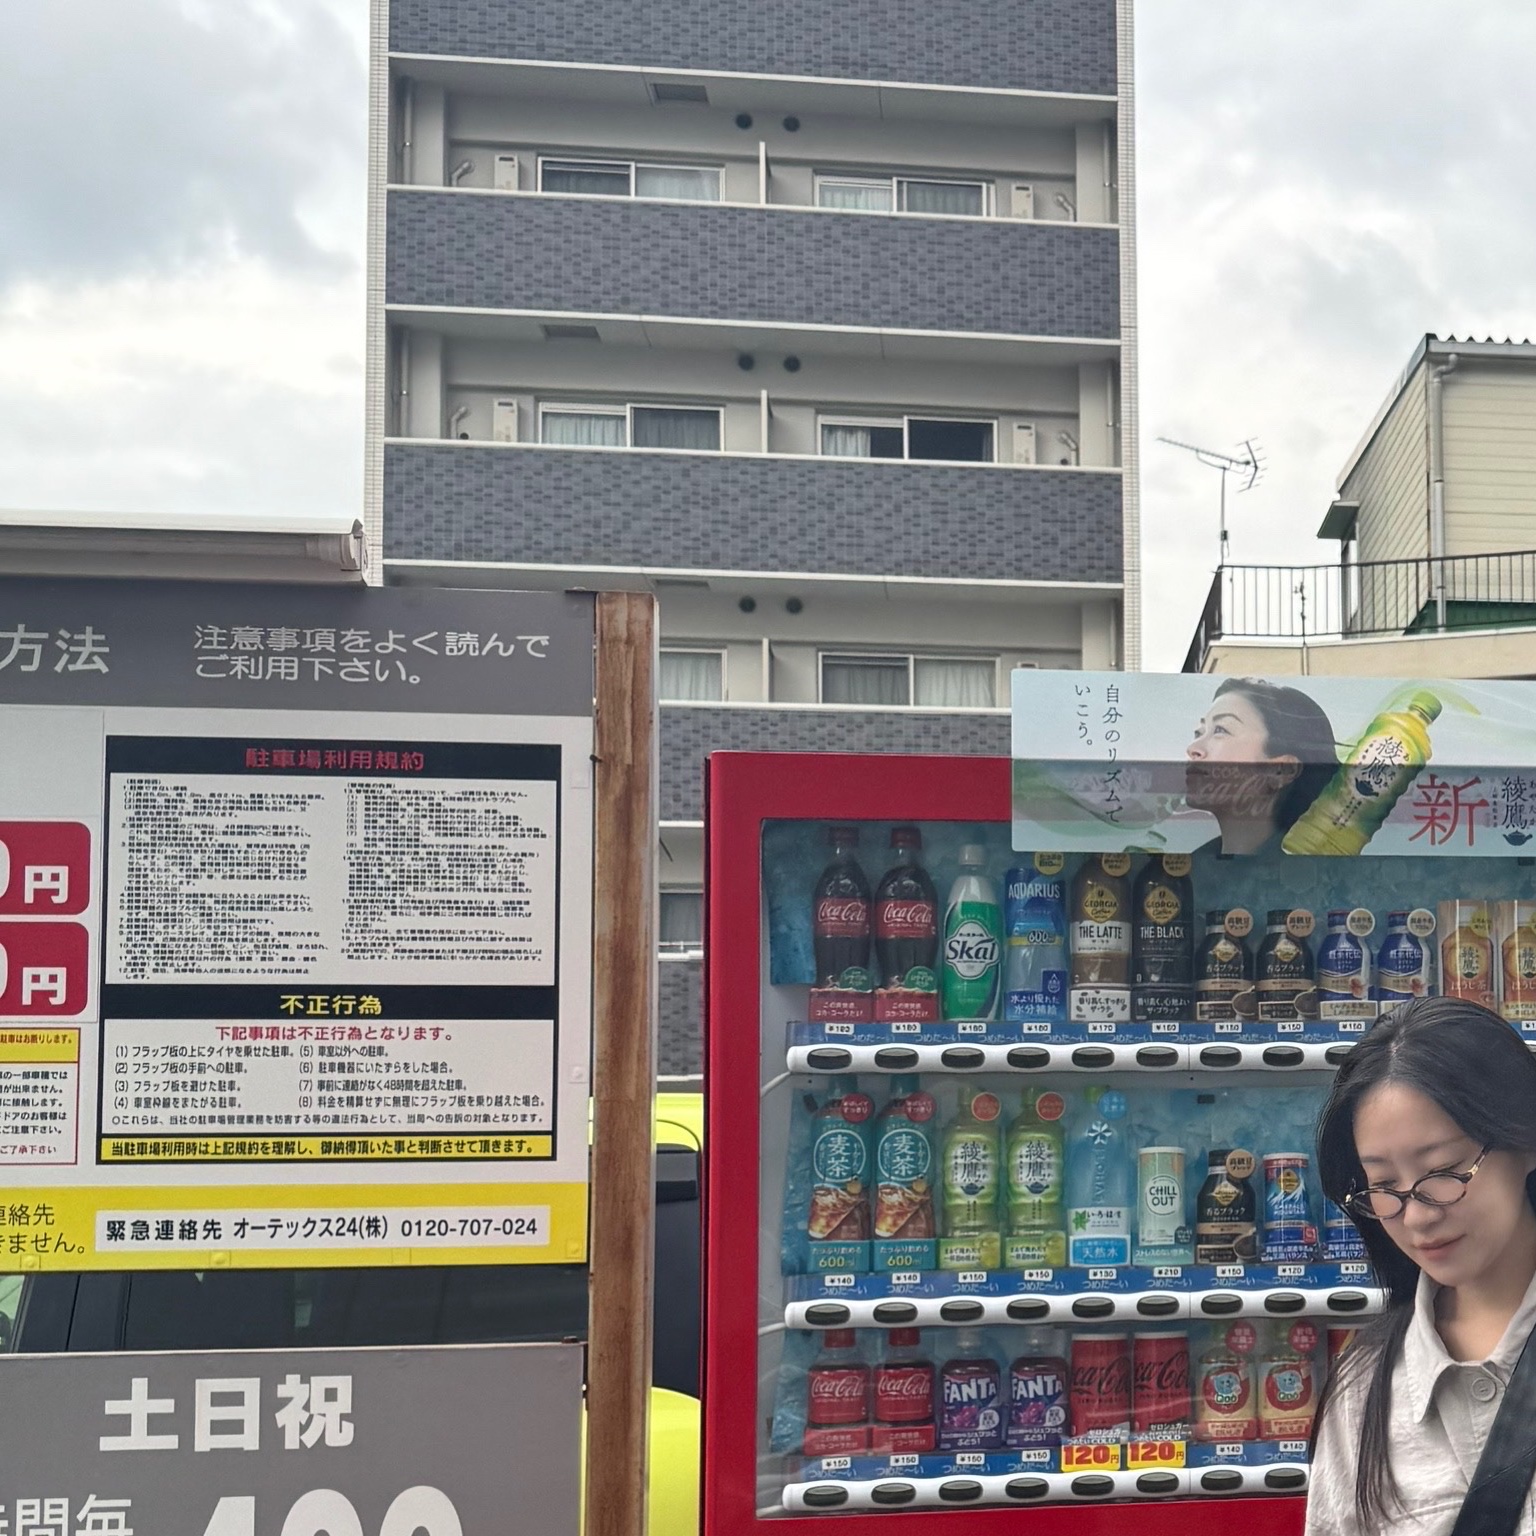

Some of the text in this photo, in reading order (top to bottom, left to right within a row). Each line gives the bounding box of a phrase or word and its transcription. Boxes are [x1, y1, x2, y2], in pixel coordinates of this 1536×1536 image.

[0, 624, 109, 674] 方法
[195, 624, 550, 659] 注意事項をよく読んで
[196, 657, 421, 684] ご利用下さい。
[1075, 684, 1093, 746] いこう。
[245, 747, 424, 771] 駐車場利用規約
[1102, 684, 1123, 823] 自分のリズムで
[1408, 774, 1490, 847] 新
[1501, 775, 1529, 830] 綾鷹
[1008, 881, 1061, 899] AQUARIUS
[818, 902, 866, 922] Coca-Cola
[883, 903, 932, 923] Coca-Cola
[1084, 900, 1117, 909] GEORGIA
[1146, 901, 1179, 909] GEORGIA
[1079, 926, 1122, 939] THE LATTE
[1141, 926, 1185, 939] THE BLACK
[280, 994, 382, 1016] 不正行為
[216, 1026, 453, 1042] 下記事項は不正行為となります。
[115, 1045, 389, 1059] (1) フラップ板の上にタイヤを乗せた駐車。 (5) 車室以外への駐車。
[115, 1062, 453, 1076] (2) フラップ板の手前への駐車。 (6) 駐車機器にいたずらをした場合。
[0, 1084, 63, 1094] が出来ません。
[114, 1079, 467, 1093] (3) フラップ板を避けた駐車。 (7) 事前に連絡がなく48時間を超えた駐車。
[0, 1098, 63, 1107] に接触します。
[114, 1097, 129, 1109] (4)
[134, 1096, 242, 1109] 車室枠線をまたがる駐車。
[299, 1096, 313, 1109] (8)
[0, 1111, 67, 1121] ドアのお客様は
[0, 1125, 62, 1135] ご注意下さい。
[827, 1134, 851, 1177] 麦茶
[892, 1134, 916, 1177] 麦茶
[1149, 1185, 1178, 1196] CHILL
[1152, 1196, 1175, 1207] OUT
[0, 1204, 55, 1226] 絡先
[106, 1216, 538, 1241] 緊急連絡先 オーテックス24(株) 0120-707-024
[0, 1231, 86, 1255] ません。
[811, 1375, 864, 1398] Coca-Cola
[878, 1373, 931, 1396] Coca-Cola
[943, 1377, 997, 1403] FANTA
[1012, 1374, 1063, 1400] FANTA
[99, 1374, 355, 1452] 土日祝
[1063, 1444, 1120, 1466] 120円
[1129, 1441, 1184, 1463] 120円
